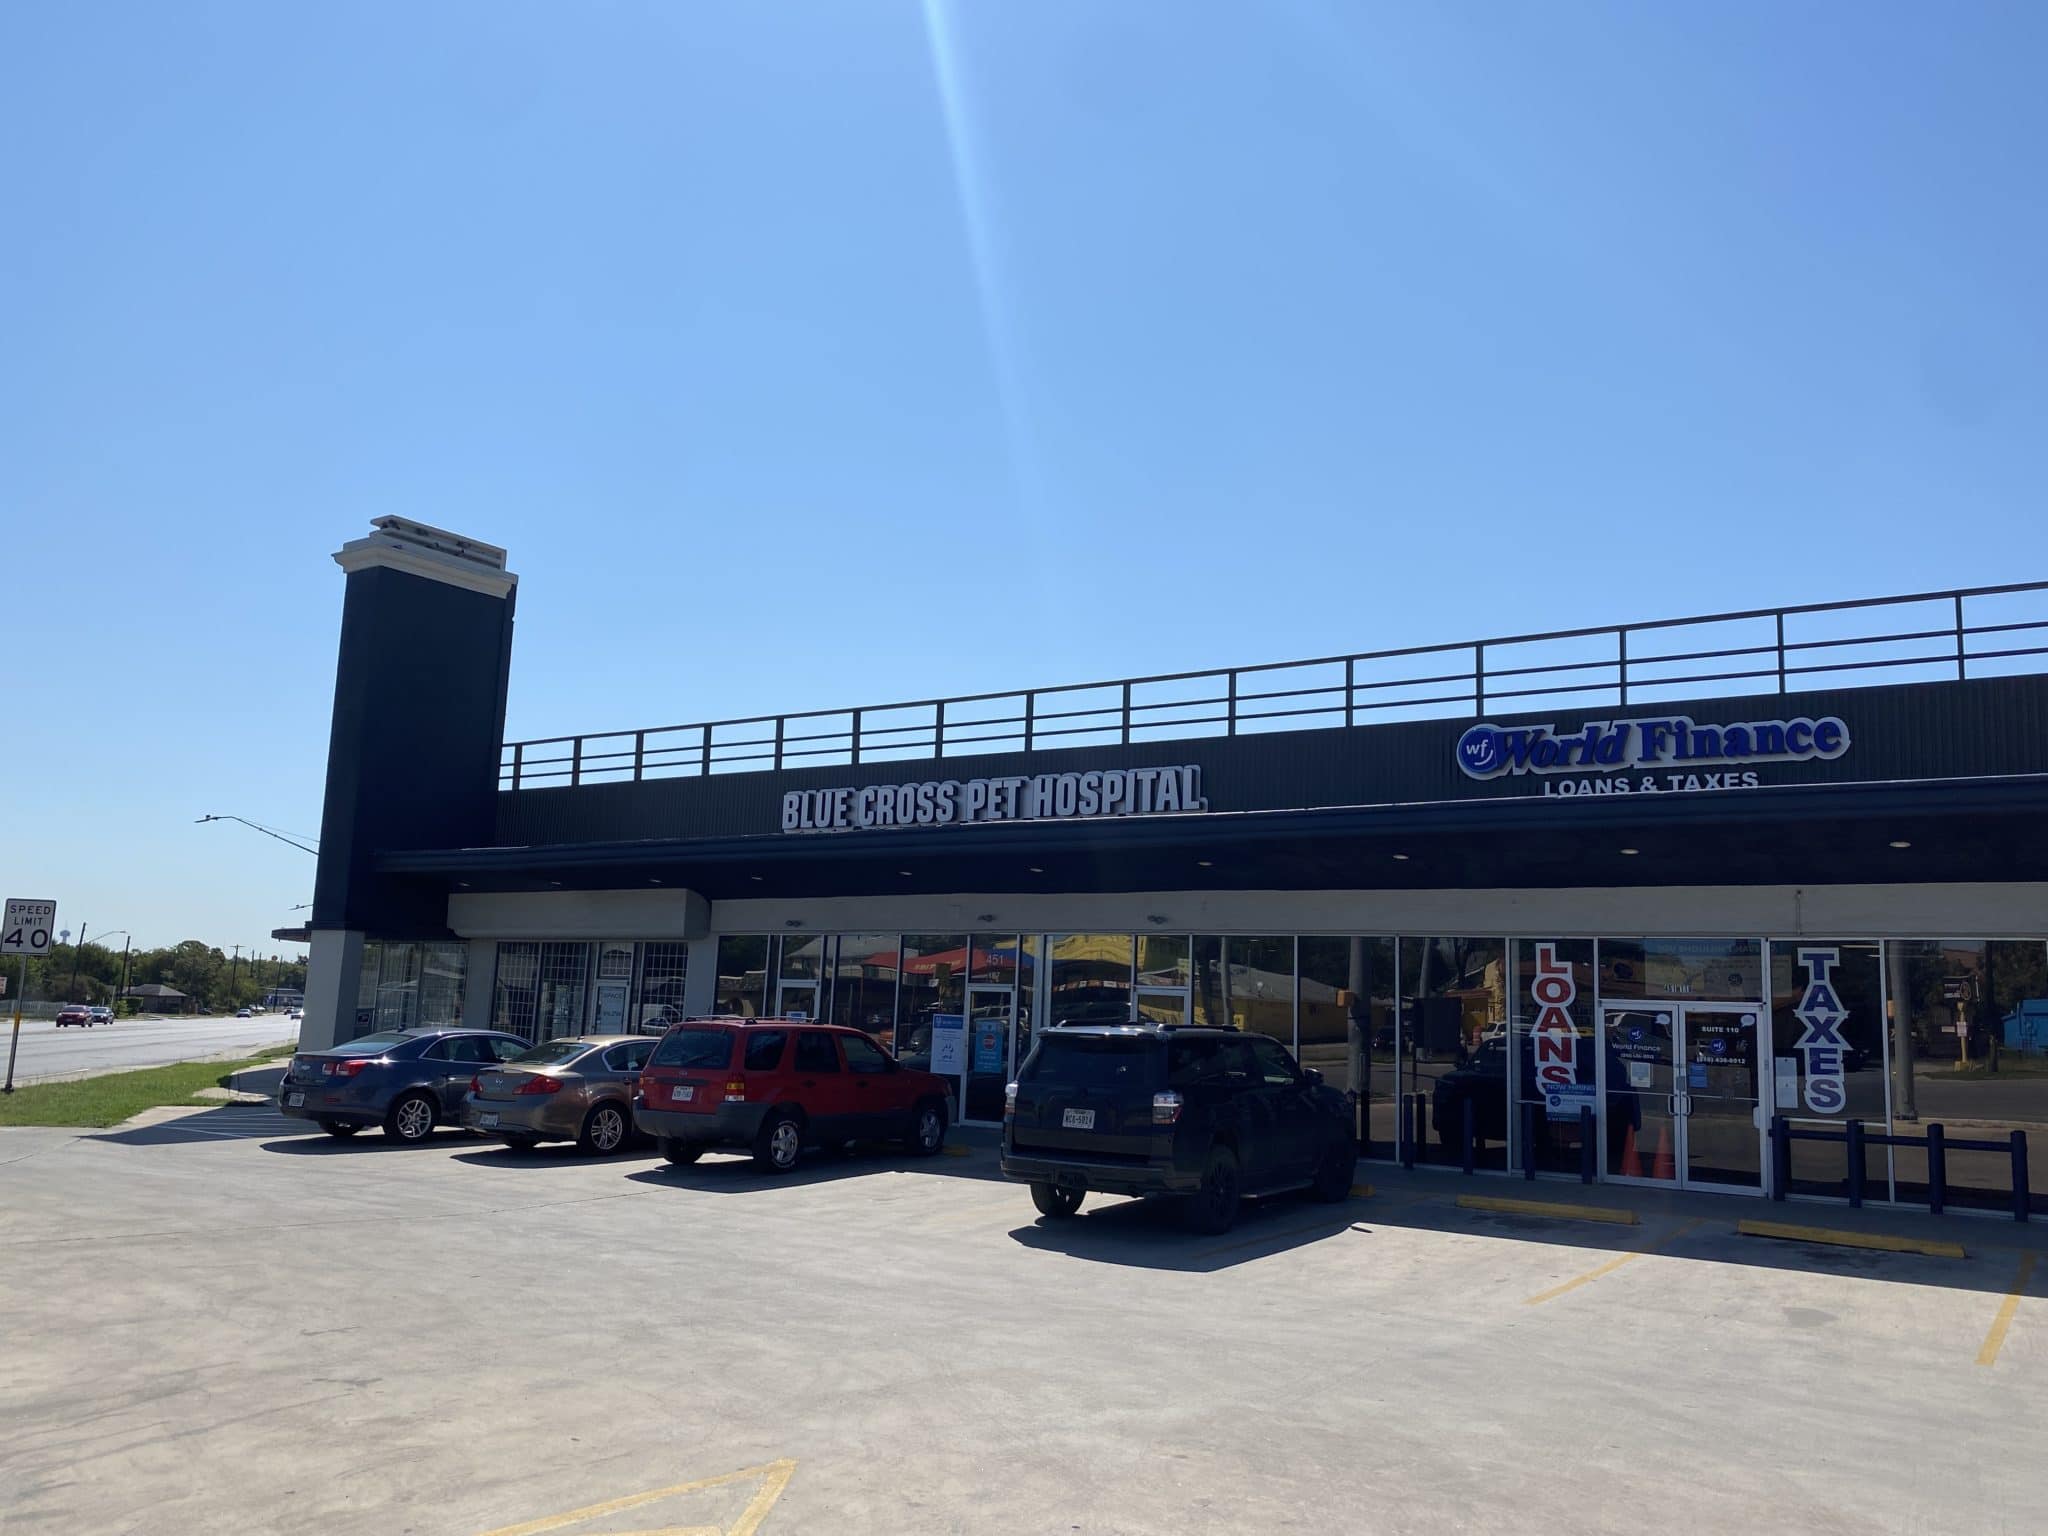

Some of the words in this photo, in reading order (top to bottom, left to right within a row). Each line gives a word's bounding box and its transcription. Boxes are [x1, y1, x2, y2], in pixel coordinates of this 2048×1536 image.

[1496, 723, 1632, 769] World
[1637, 719, 1842, 762] Finance
[1544, 777, 1631, 797] LOANS
[1640, 776, 1658, 792] &
[1667, 771, 1759, 791] TAXES
[782, 789, 852, 829] BLUE
[858, 779, 957, 827] CROSS
[967, 776, 1024, 820] PET
[1033, 765, 1202, 817] HOSPITAL
[10, 905, 51, 914] SPEED
[14, 917, 43, 926] LIMIT
[4, 928, 49, 948] 40
[986, 954, 1004, 965] 451
[1533, 945, 1575, 1088] LOANS
[1798, 950, 1846, 1110] TAXES
[1611, 1042, 1632, 1050] World
